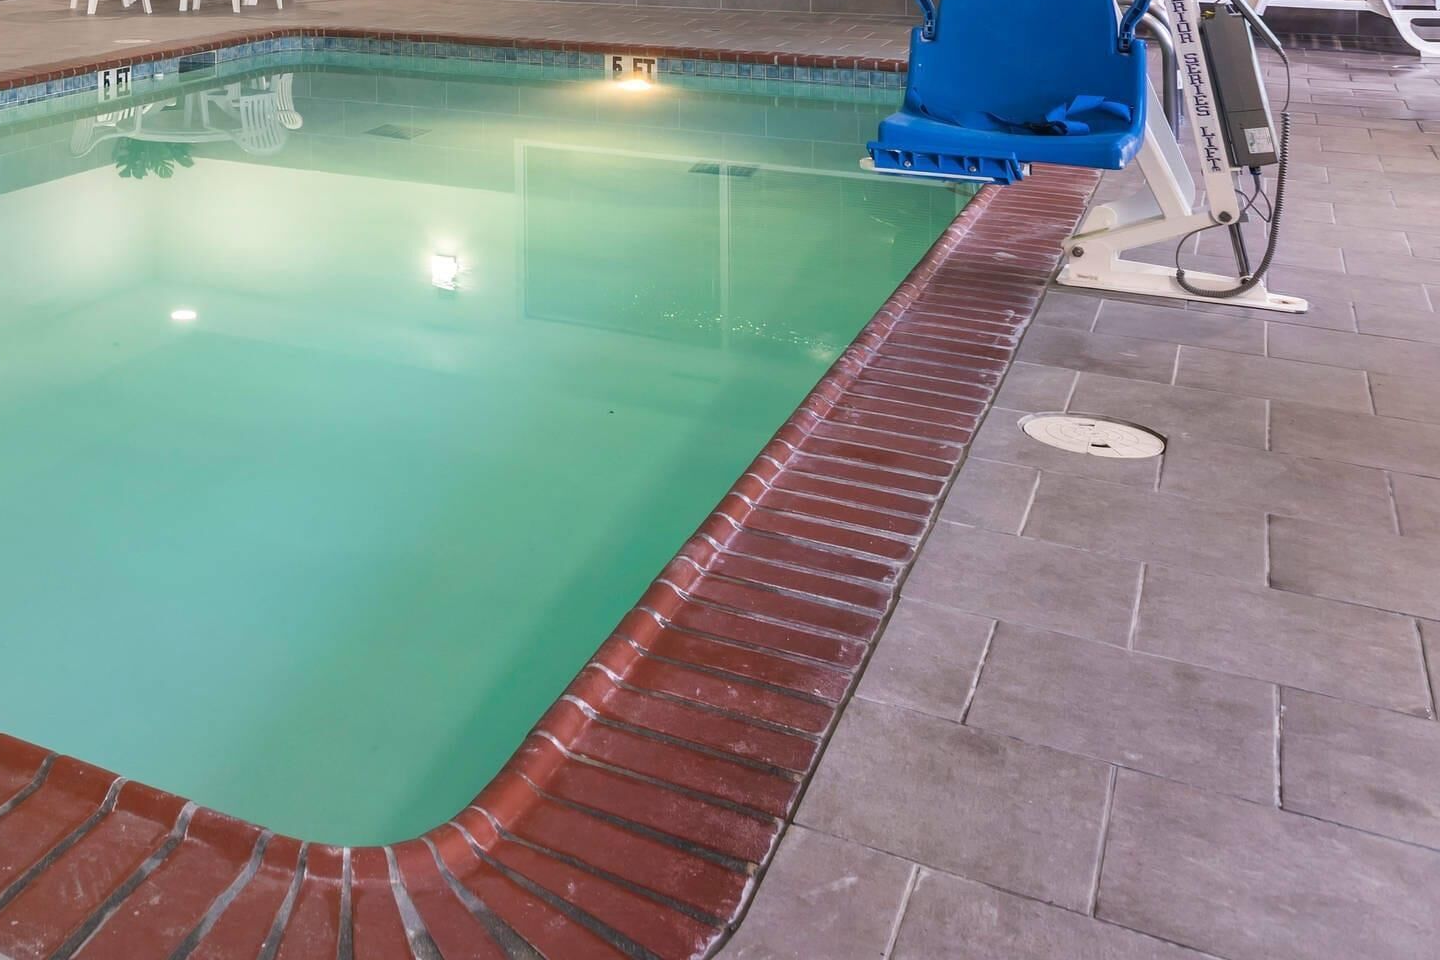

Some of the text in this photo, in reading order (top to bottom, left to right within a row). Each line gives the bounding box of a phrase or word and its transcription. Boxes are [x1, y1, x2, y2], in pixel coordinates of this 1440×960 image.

[633, 58, 655, 73] FT
[117, 68, 130, 84] FT
[1183, 52, 1210, 117] SERIES
